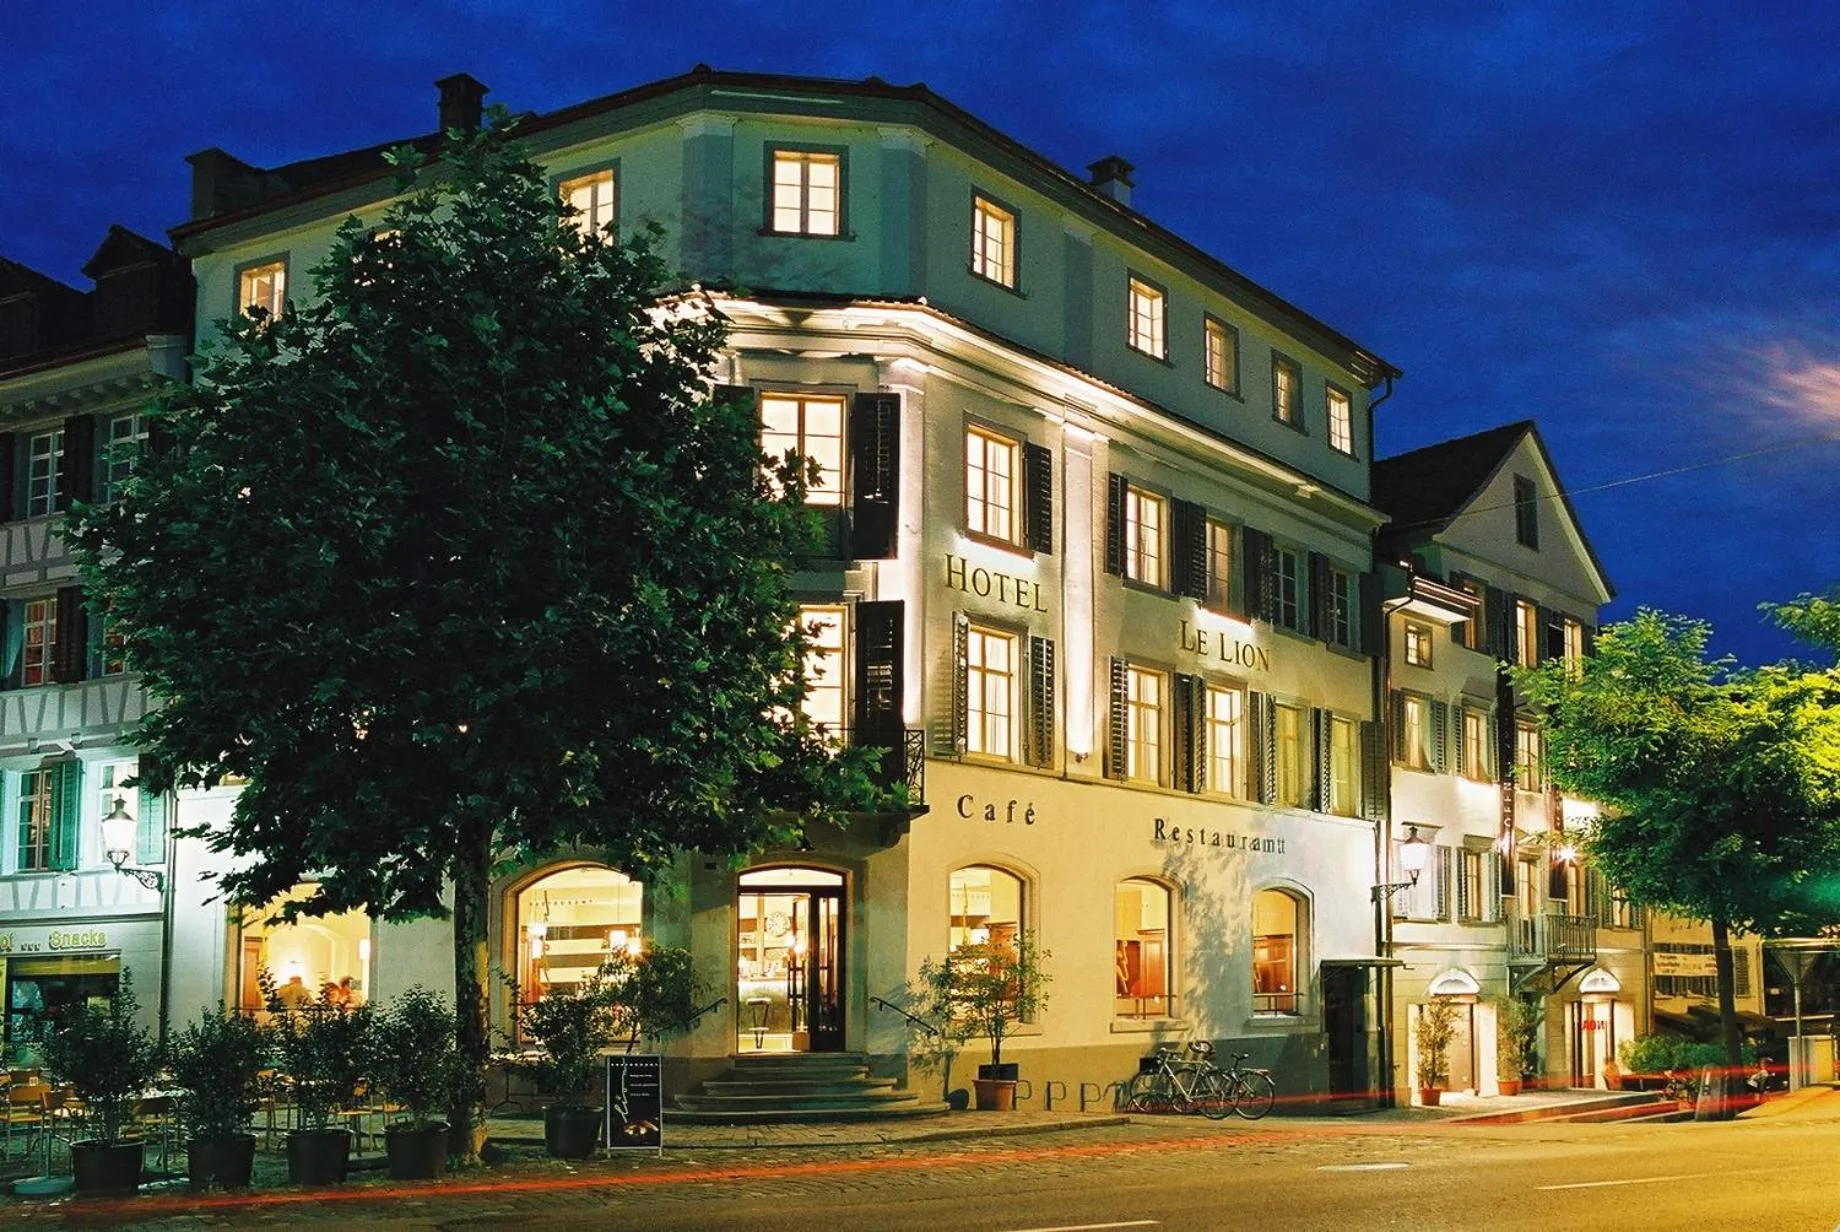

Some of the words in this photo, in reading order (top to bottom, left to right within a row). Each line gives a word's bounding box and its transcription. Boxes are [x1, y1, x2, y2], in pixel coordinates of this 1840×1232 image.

[945, 553, 1048, 613] HOTEL
[1180, 620, 1208, 656] LE
[1219, 632, 1271, 672] LION
[957, 794, 1035, 825] Café
[49, 929, 107, 950] Snacks
